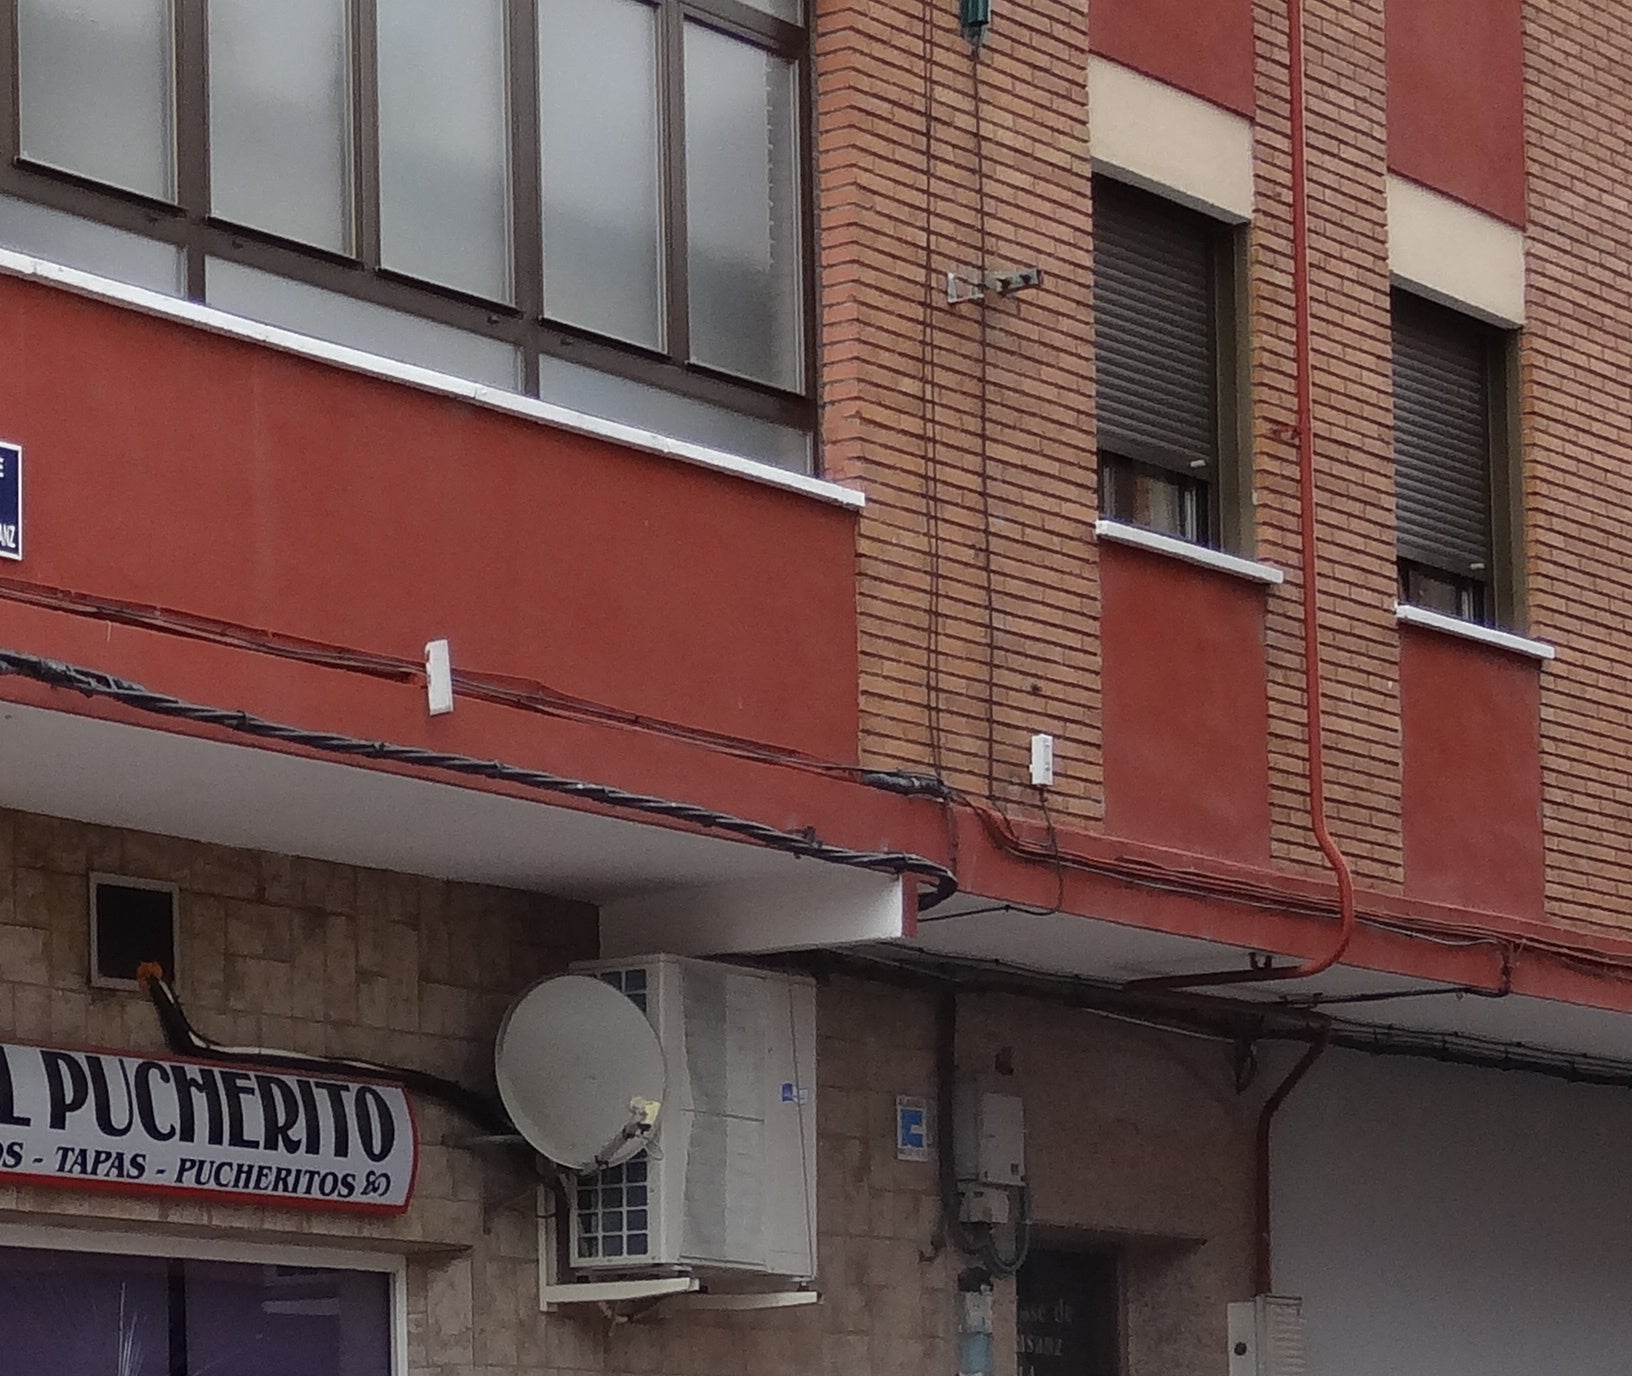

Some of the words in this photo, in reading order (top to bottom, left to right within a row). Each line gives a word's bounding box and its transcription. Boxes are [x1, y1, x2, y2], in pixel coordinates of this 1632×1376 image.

[39, 1049, 396, 1163] PUCHERITO
[55, 1146, 147, 1180] TAPAS
[175, 1161, 356, 1199] PUCHERITOS
